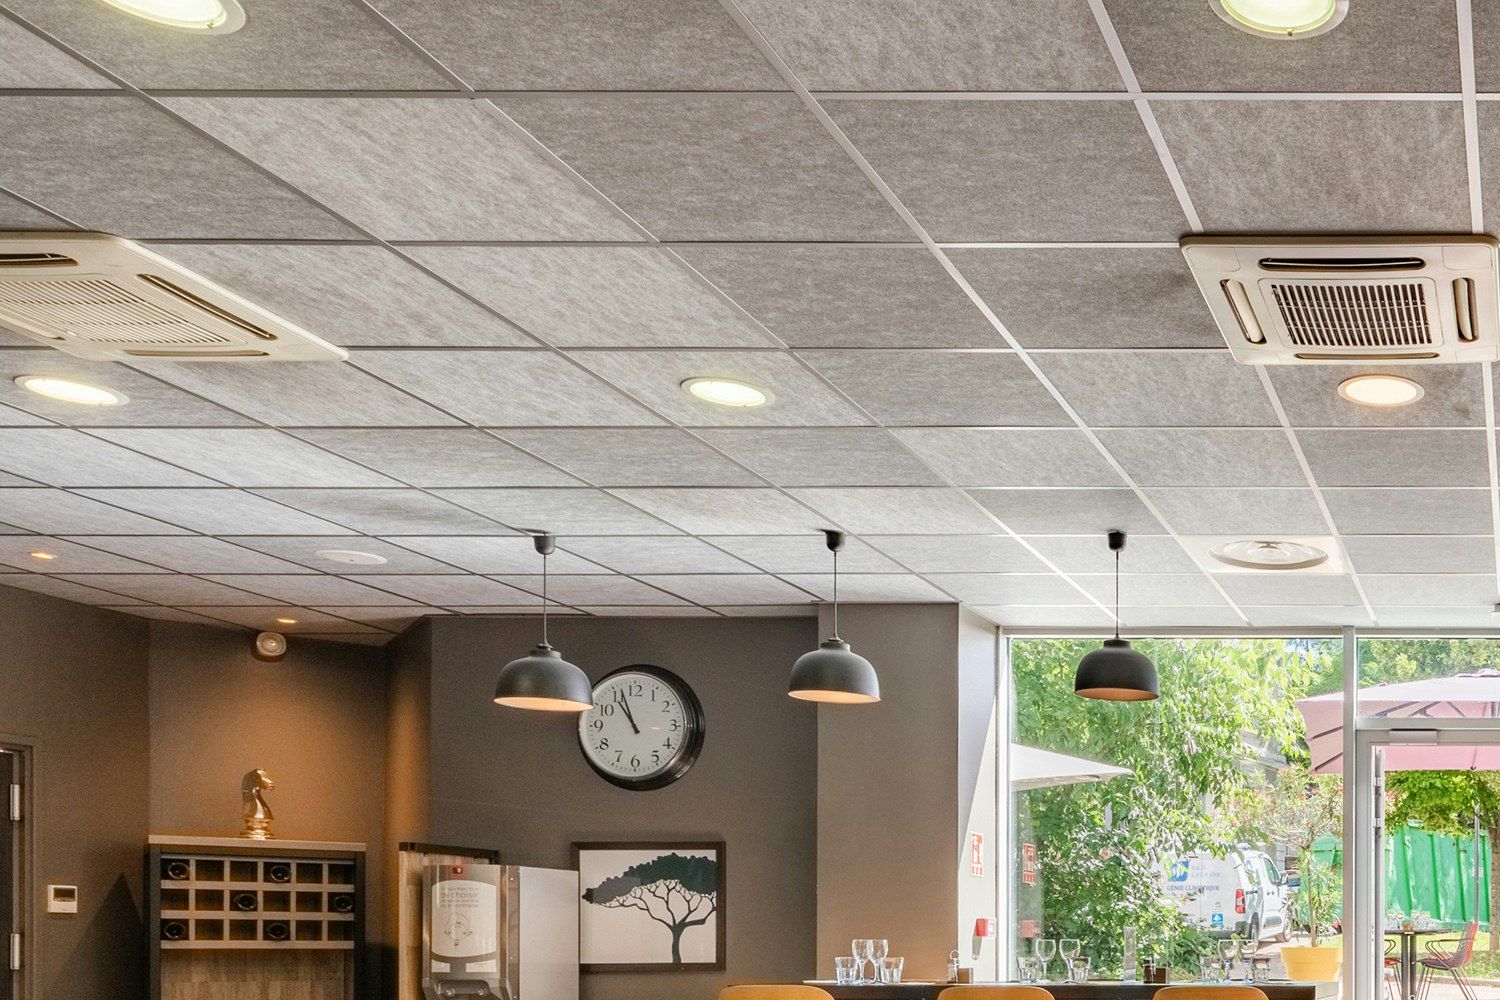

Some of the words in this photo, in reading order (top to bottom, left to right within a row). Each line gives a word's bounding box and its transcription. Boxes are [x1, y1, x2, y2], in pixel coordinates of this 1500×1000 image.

[628, 684, 643, 697] 12
[600, 704, 614, 717] 10
[662, 701, 670, 713] 2
[594, 720, 604, 733] 9
[669, 719, 677, 732] 3
[600, 738, 609, 750] 8
[663, 737, 672, 749] 4
[615, 750, 623, 762] 7
[631, 754, 640, 768] 6
[651, 750, 660, 763] 5
[451, 890, 479, 899] choisir
